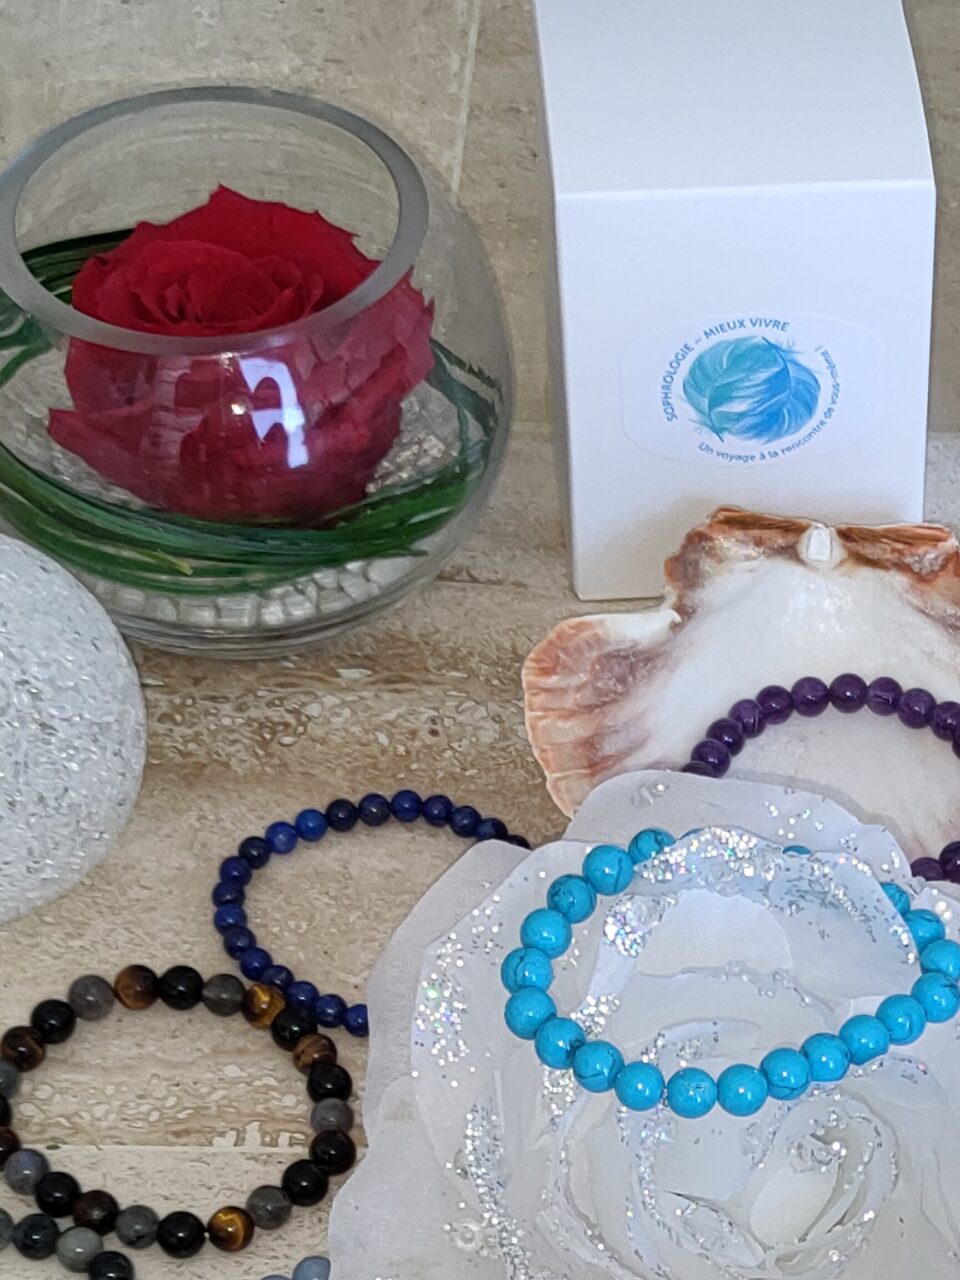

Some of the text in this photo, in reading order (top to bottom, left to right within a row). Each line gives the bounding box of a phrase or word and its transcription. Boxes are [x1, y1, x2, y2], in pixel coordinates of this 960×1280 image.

[661, 342, 694, 423] SOPHROLOGIE
[703, 318, 746, 339] MIEUX
[749, 318, 790, 332] VIVRE
[698, 441, 714, 455] Un
[716, 450, 756, 464] voyage
[759, 452, 766, 461] à
[768, 449, 779, 459] la
[781, 419, 827, 455] rencontre
[822, 407, 835, 422] de
